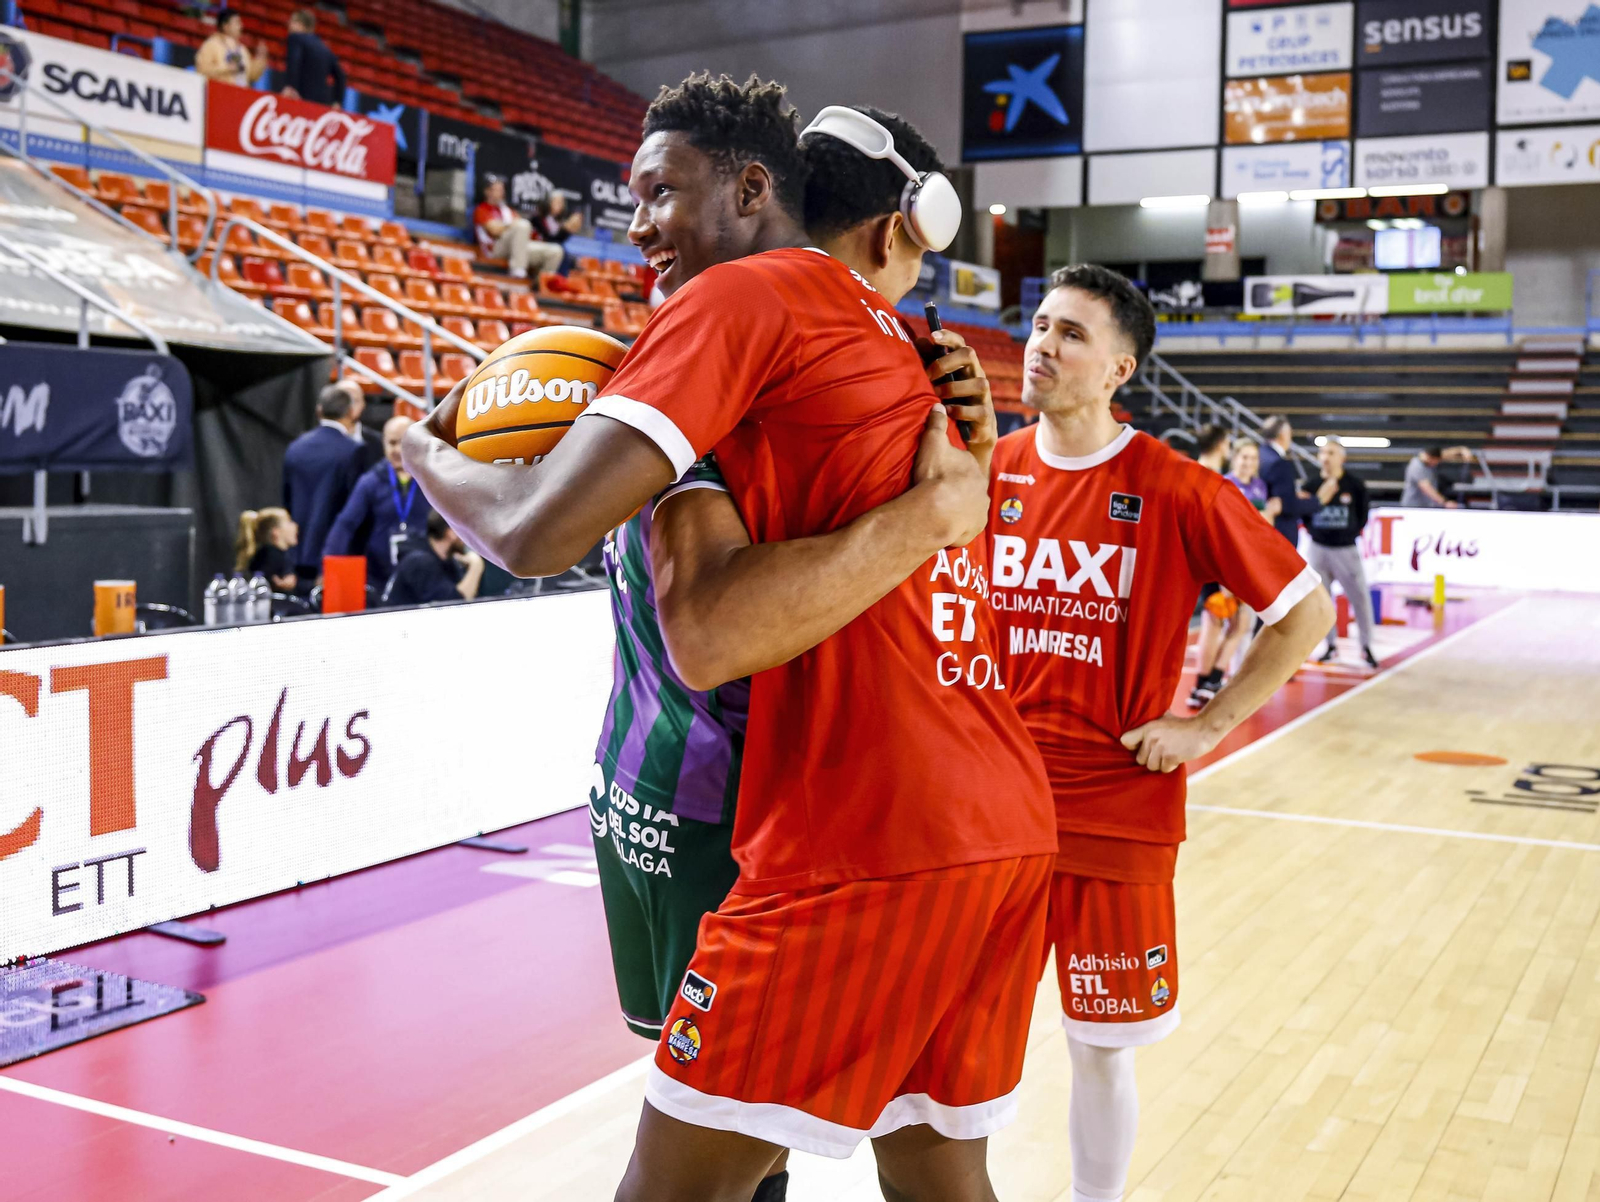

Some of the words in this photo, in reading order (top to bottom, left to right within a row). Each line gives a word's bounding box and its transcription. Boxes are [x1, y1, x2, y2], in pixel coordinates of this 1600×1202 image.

[1364, 12, 1483, 45] sensus
[43, 62, 190, 122] SCANIA
[239, 94, 374, 176] Coca-Cola
[466, 369, 599, 421] Wilson
[992, 533, 1138, 600] BAXI
[1410, 531, 1480, 571] plus
[991, 591, 1129, 624] CLIMATIZACIÓN
[189, 686, 372, 874] plus
[608, 806, 627, 839] DEL
[628, 821, 676, 854] SOL
[51, 847, 147, 917] ETT
[1067, 952, 1140, 972] Adbisio
[1069, 973, 1110, 995] ETL
[684, 983, 705, 1004] acb
[1072, 997, 1145, 1015] GLOBAL
